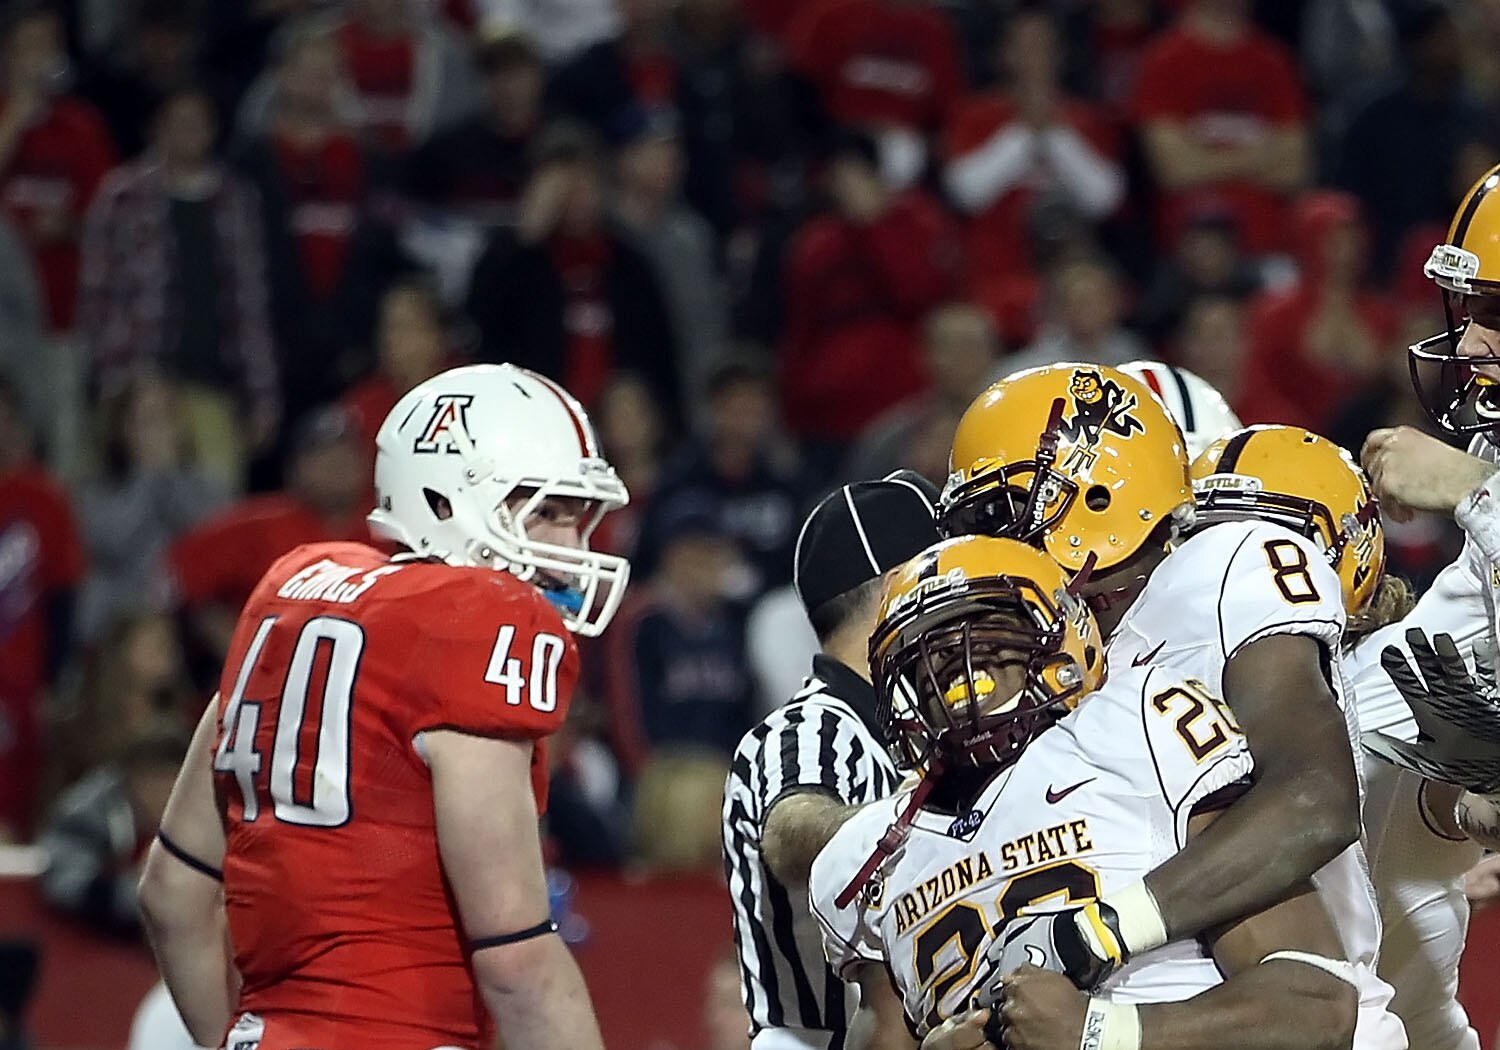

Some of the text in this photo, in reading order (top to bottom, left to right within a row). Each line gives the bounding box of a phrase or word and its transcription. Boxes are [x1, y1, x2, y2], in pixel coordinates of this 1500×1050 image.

[1262, 537, 1322, 605] 8
[484, 624, 566, 713] 40
[213, 615, 367, 828] 40
[894, 819, 1095, 933] ARIZONA STATE
